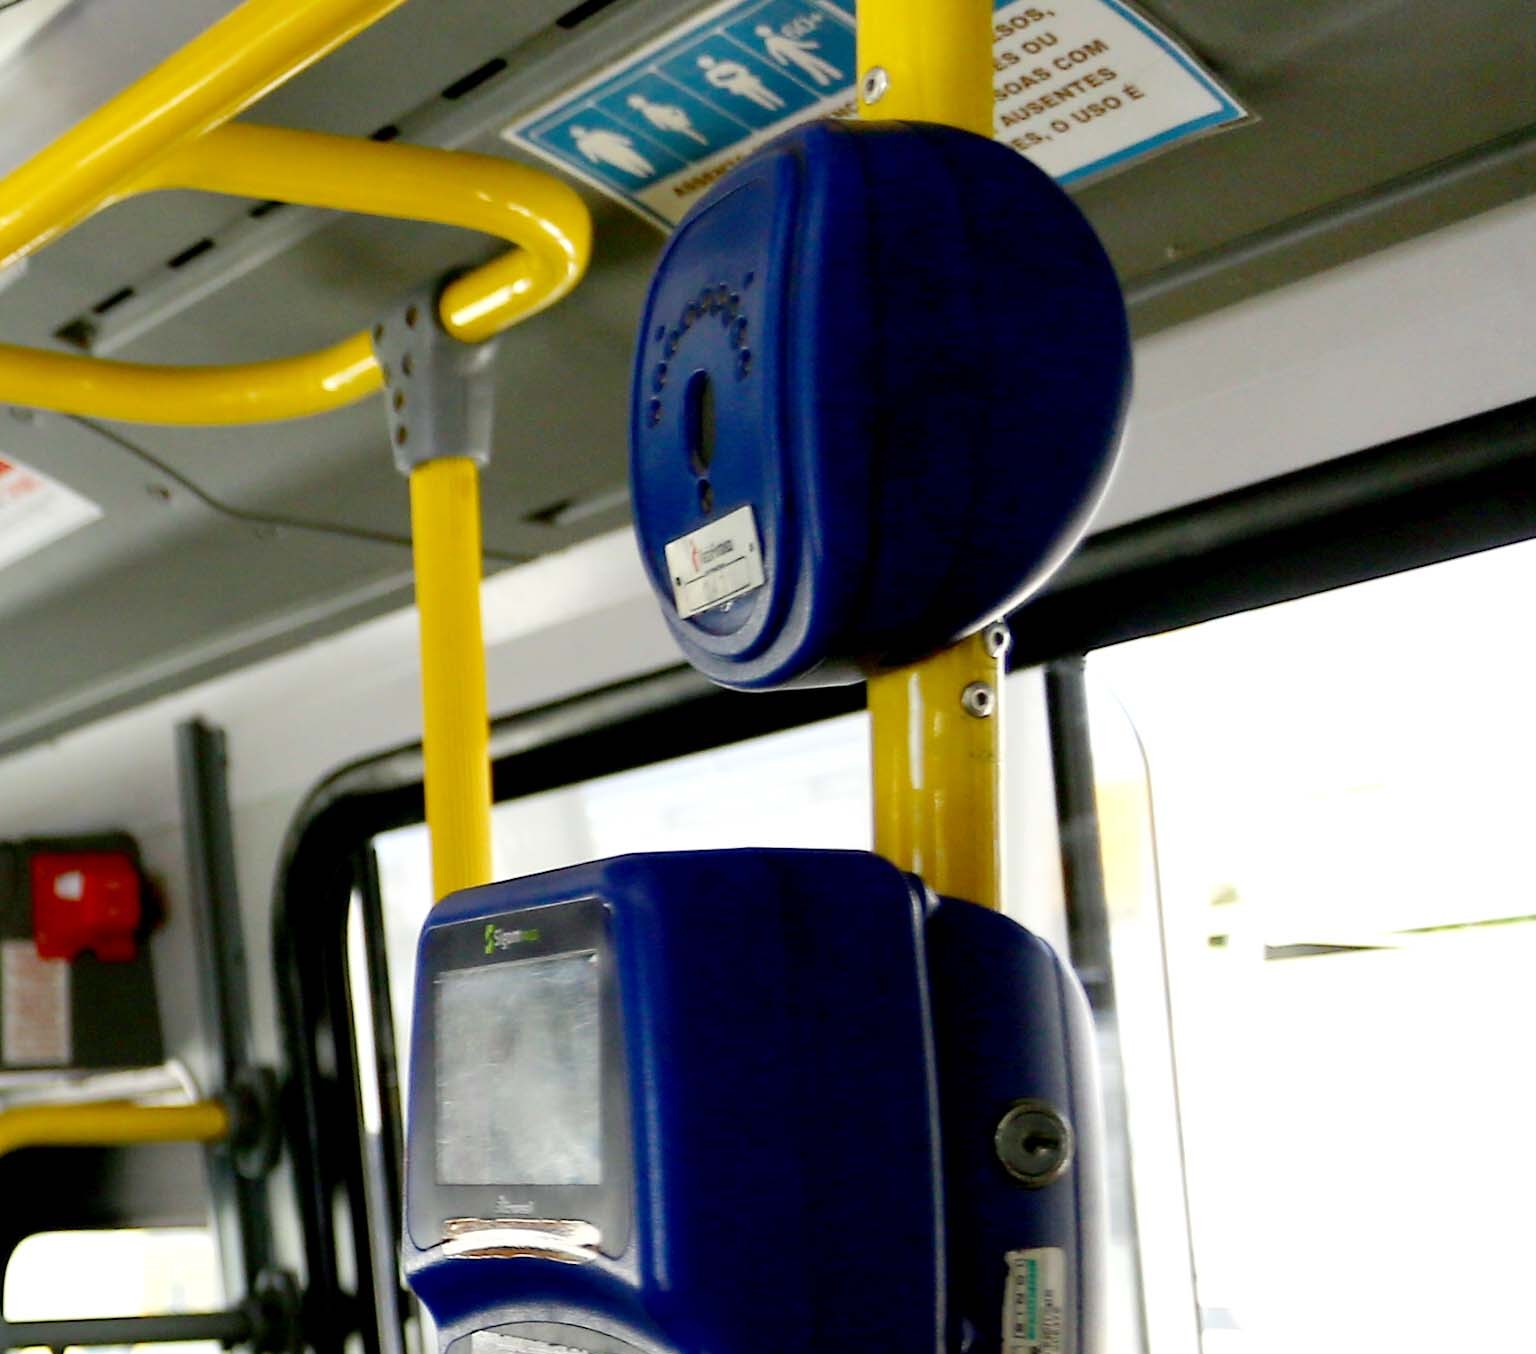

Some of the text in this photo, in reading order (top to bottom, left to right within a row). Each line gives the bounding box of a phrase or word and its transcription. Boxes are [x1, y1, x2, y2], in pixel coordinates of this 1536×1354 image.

[992, 7, 1055, 44] SOS,
[1022, 32, 1058, 55] OU
[1053, 39, 1109, 71] COM
[1000, 67, 1118, 127] AUSENTES
[1051, 119, 1070, 134] O
[1071, 96, 1121, 124] USO
[1123, 83, 1145, 101] É
